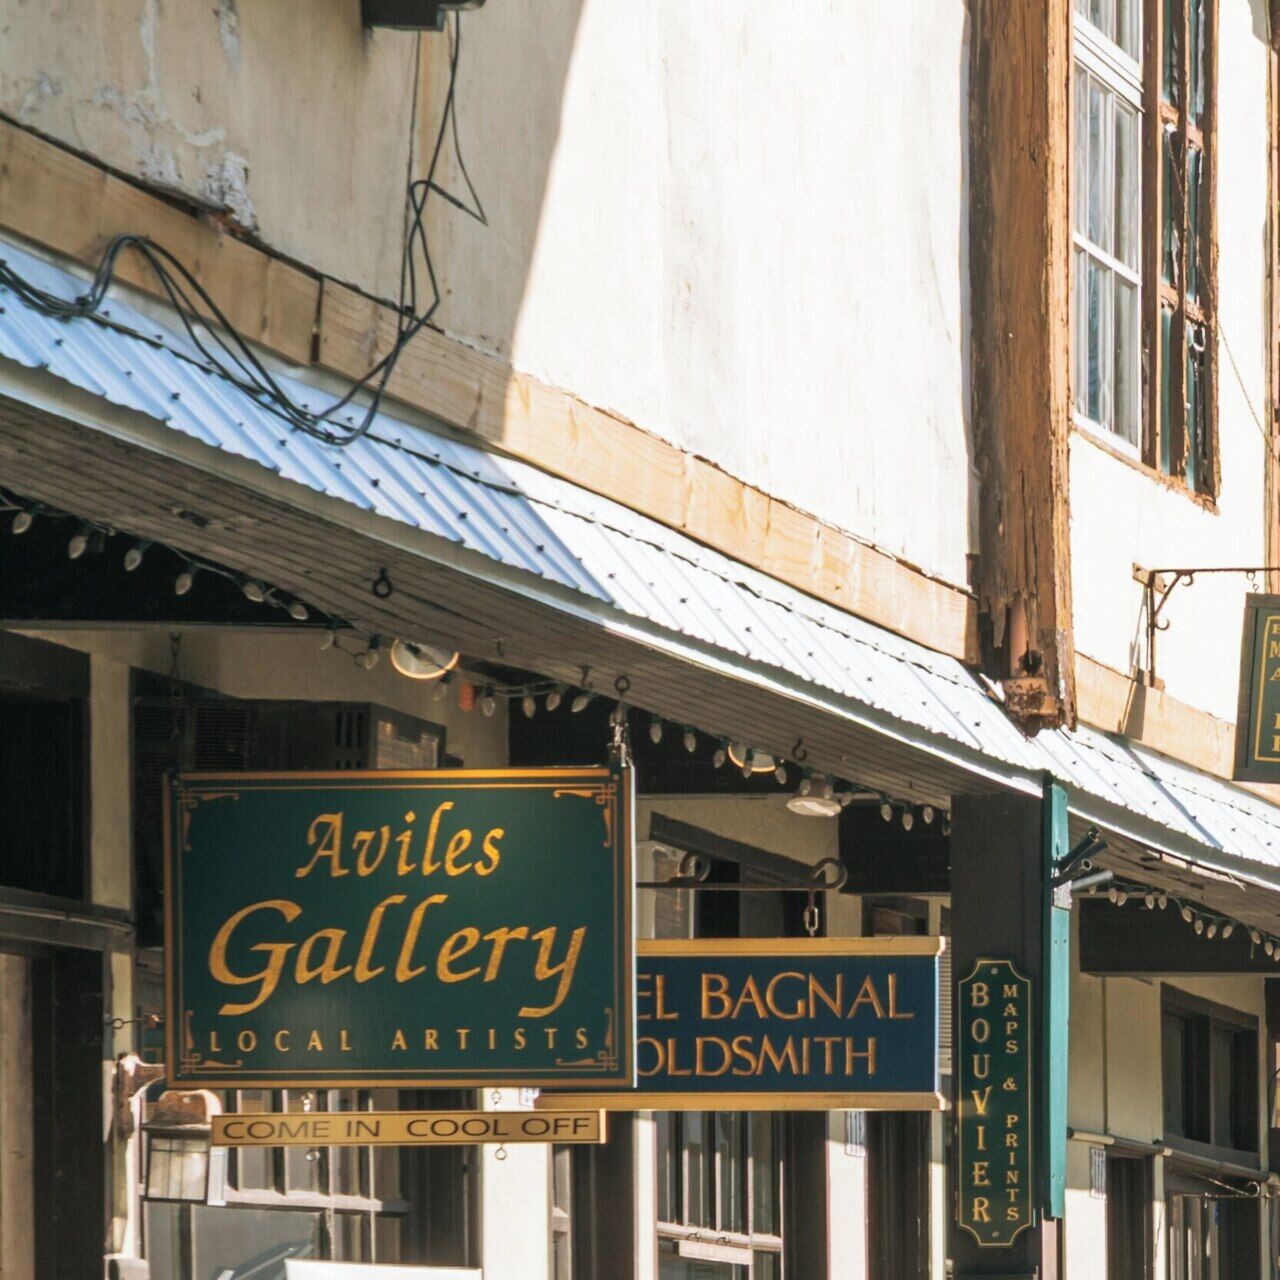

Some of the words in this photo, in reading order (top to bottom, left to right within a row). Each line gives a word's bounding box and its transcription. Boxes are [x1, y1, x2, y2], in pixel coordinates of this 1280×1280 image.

[295, 801, 505, 878] Aviles
[208, 894, 587, 1018] Gallery
[701, 971, 915, 1020] BAGNAL
[1002, 984, 1019, 1054] MAPS
[210, 1029, 352, 1052] LOCAL
[391, 1028, 589, 1051] ARTISTS
[971, 982, 992, 1223] BOUVIER
[1002, 1077, 1018, 1091] &
[222, 1119, 331, 1141] COME
[346, 1119, 381, 1138] IN
[405, 1117, 509, 1138] COOL
[521, 1116, 591, 1136] OFF
[1005, 1114, 1020, 1221] PRINTS
